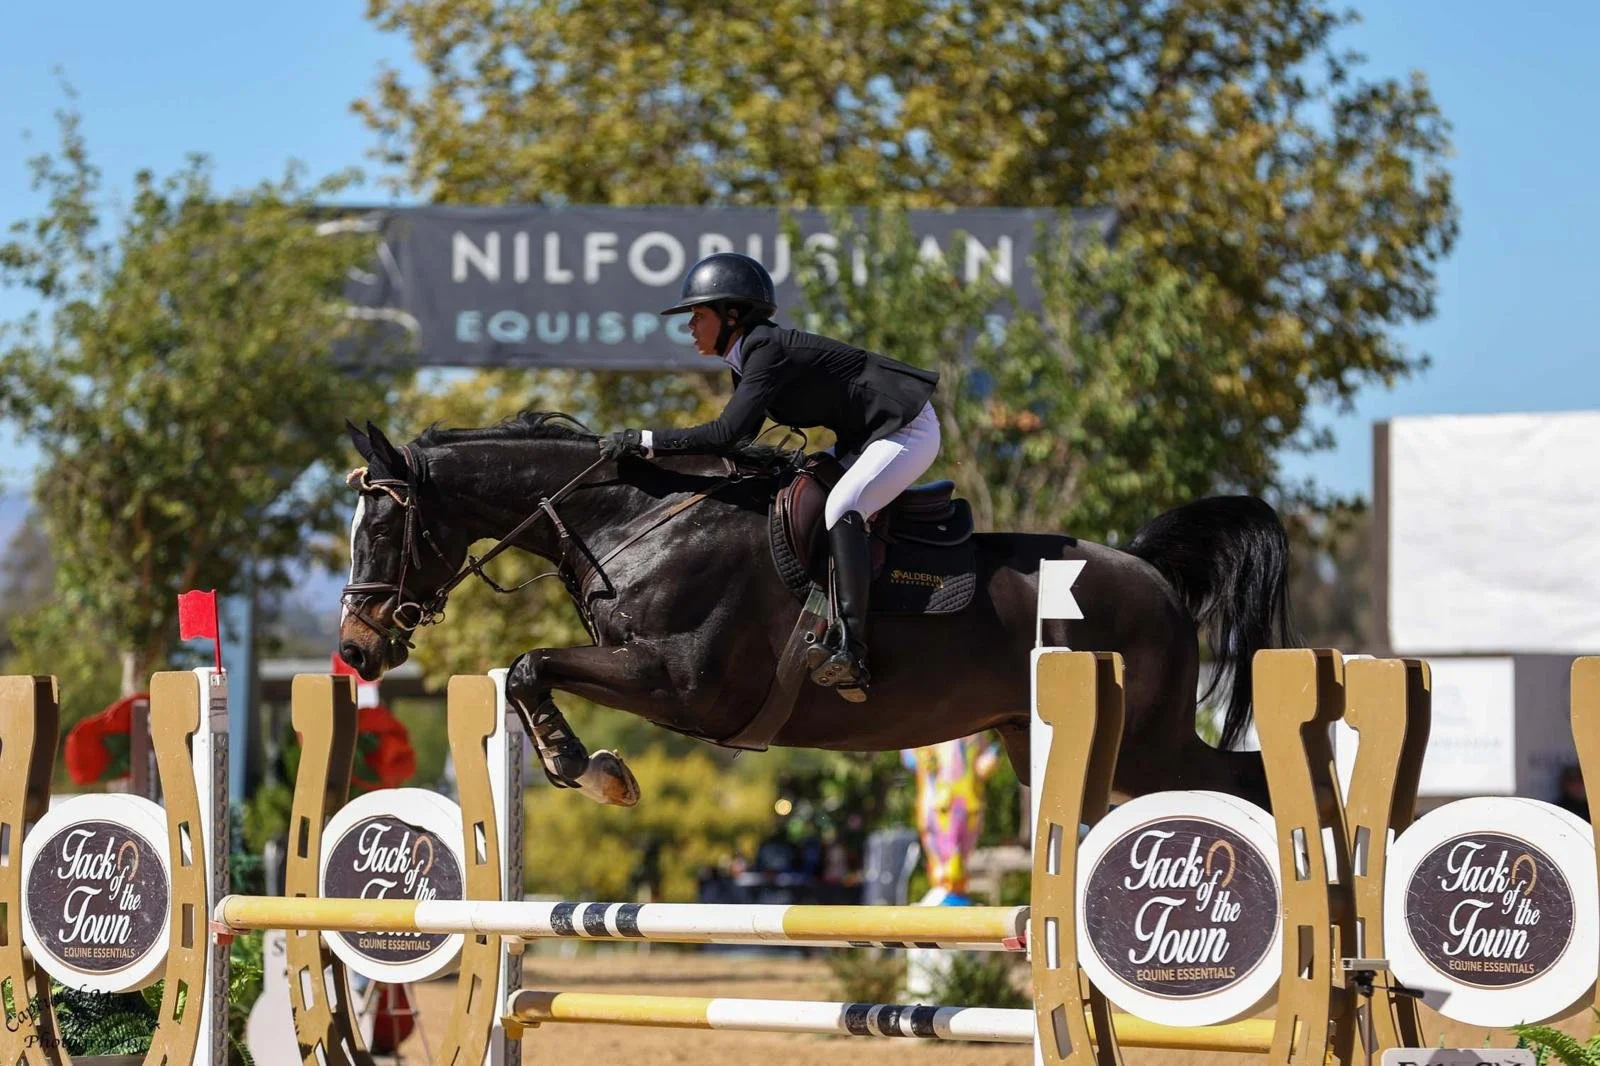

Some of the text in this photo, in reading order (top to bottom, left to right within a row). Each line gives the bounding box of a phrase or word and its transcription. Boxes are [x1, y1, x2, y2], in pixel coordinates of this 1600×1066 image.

[109, 866, 129, 900] of
[119, 884, 141, 911] the
[403, 860, 424, 893] of
[414, 877, 437, 900] the
[1195, 869, 1223, 912] of
[1210, 891, 1241, 923] the
[1502, 880, 1527, 915] of
[59, 886, 132, 945] Town
[1128, 896, 1230, 965] Town
[1442, 898, 1529, 960] Town
[1514, 898, 1540, 926] the
[64, 947, 136, 959] EQUINE ESSENTIALS
[359, 938, 430, 951] EQUINE ESSENTIALS
[1137, 967, 1236, 981] EQUINE ESSENTIALS
[1449, 960, 1535, 974] EQUINE ESSENTIALS
